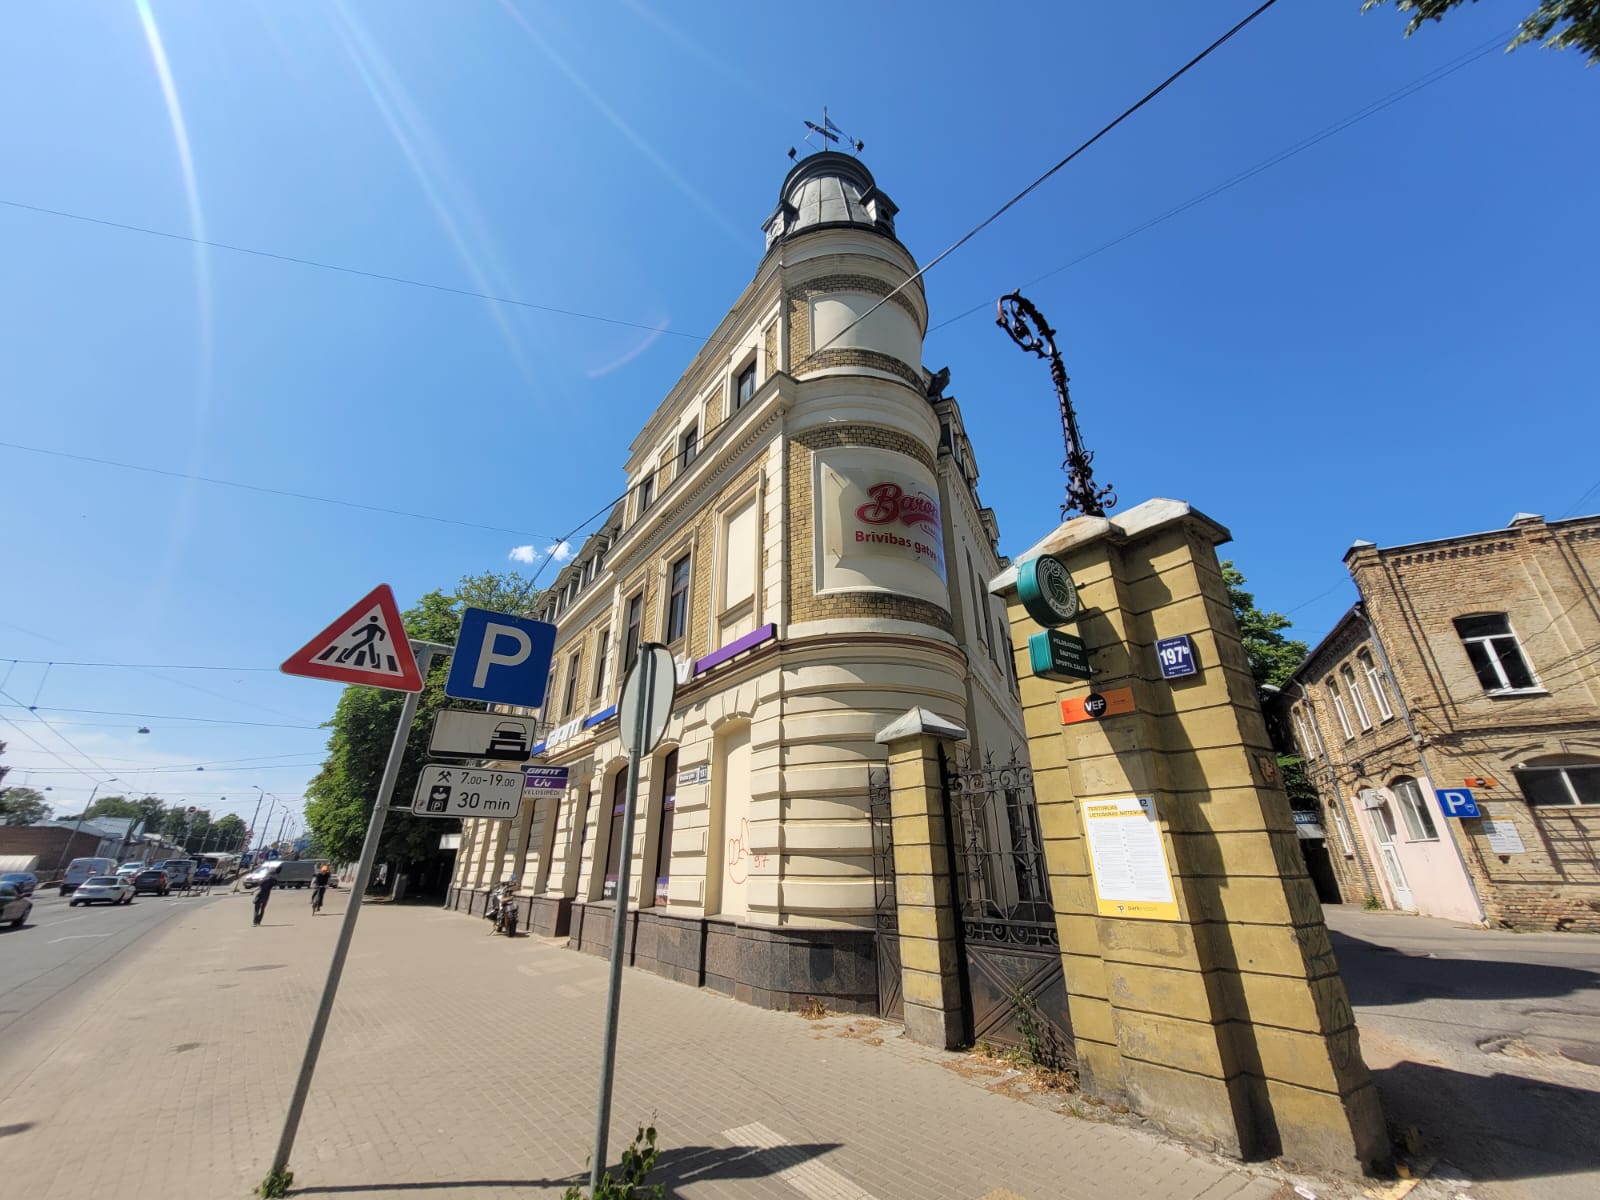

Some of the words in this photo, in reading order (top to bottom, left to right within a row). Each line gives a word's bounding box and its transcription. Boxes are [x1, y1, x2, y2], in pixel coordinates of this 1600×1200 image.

[855, 531, 912, 548] Brīvības
[472, 622, 532, 689] P
[1084, 699, 1105, 711] VEF
[526, 767, 561, 775] GIANT
[460, 772, 515, 787] 7.00-19.00
[534, 778, 552, 787] Liv
[457, 791, 480, 808] 30
[483, 797, 510, 810] min
[1444, 792, 1466, 814] P
